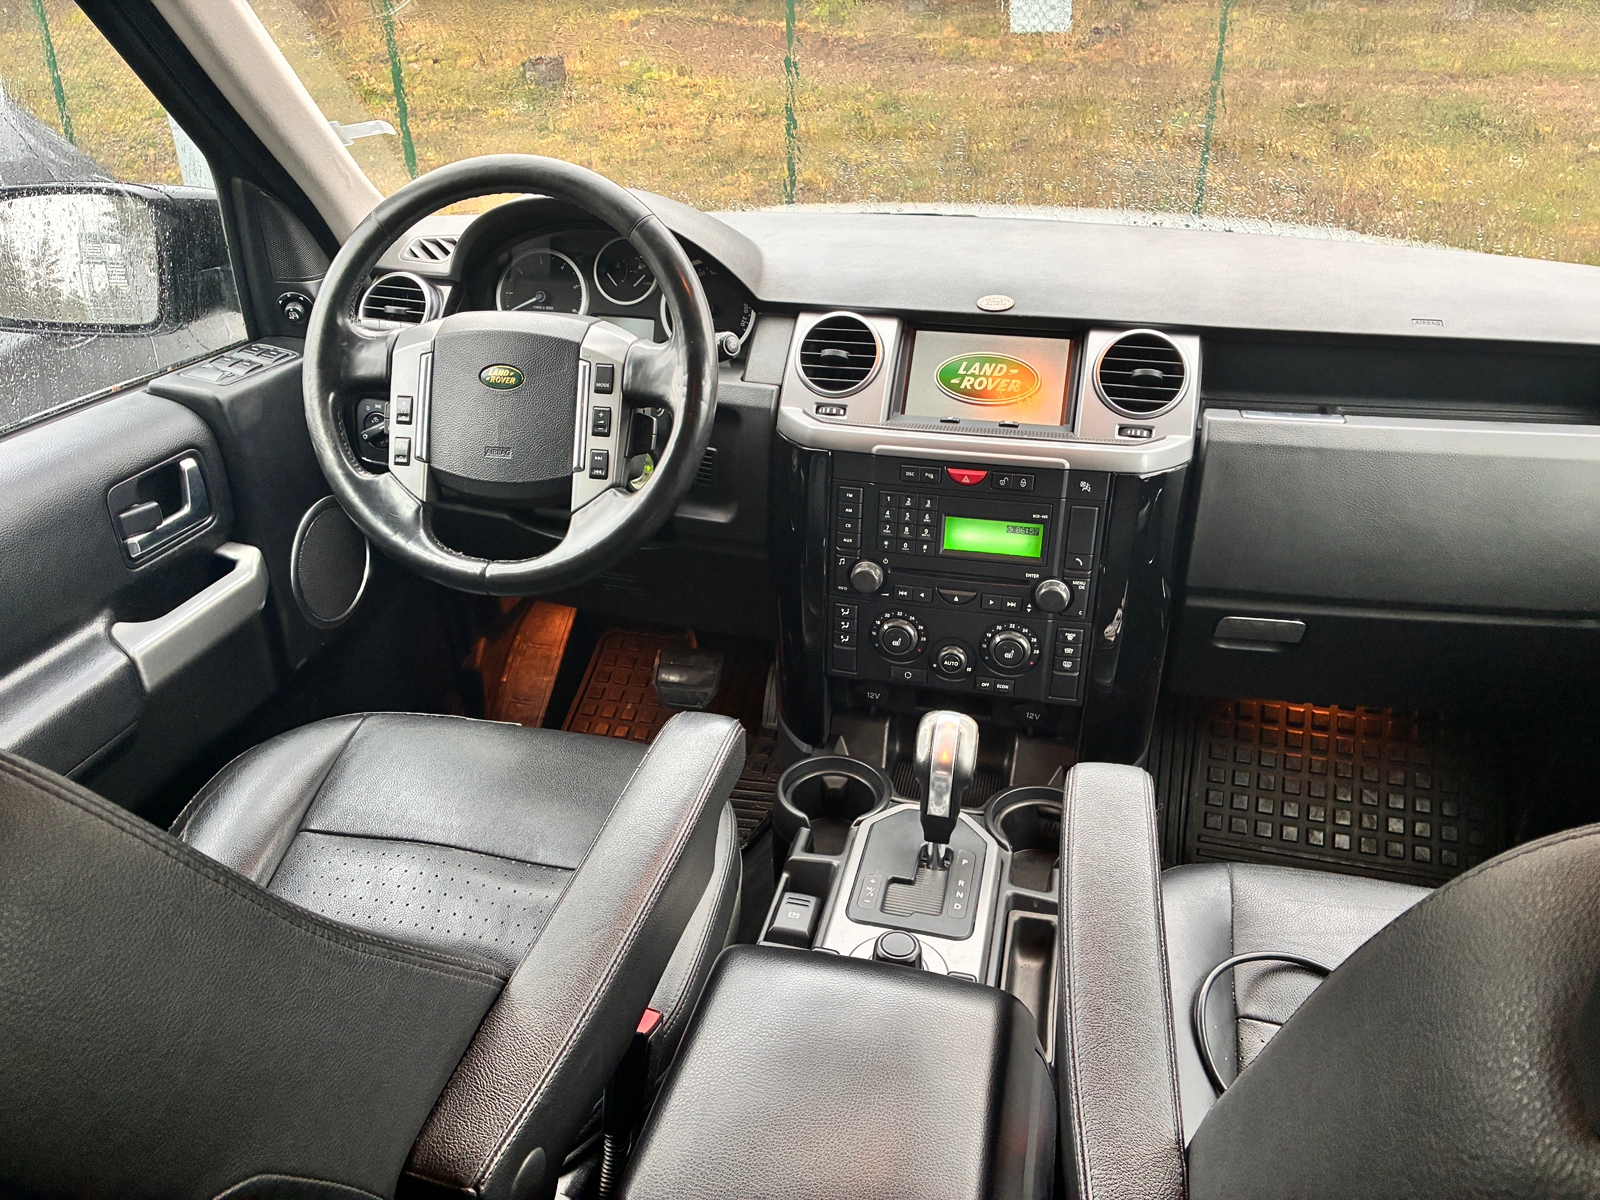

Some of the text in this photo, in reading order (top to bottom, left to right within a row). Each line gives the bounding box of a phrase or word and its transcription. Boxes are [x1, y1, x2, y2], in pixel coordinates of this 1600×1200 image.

[488, 368, 510, 377] LAND
[957, 361, 1008, 376] LAND
[490, 376, 516, 384] ROVER
[959, 376, 1022, 393] ROVER
[1015, 526, 1039, 536] 06:57
[866, 691, 881, 700] 12V
[1025, 711, 1041, 720] 12V
[955, 891, 964, 899] N
